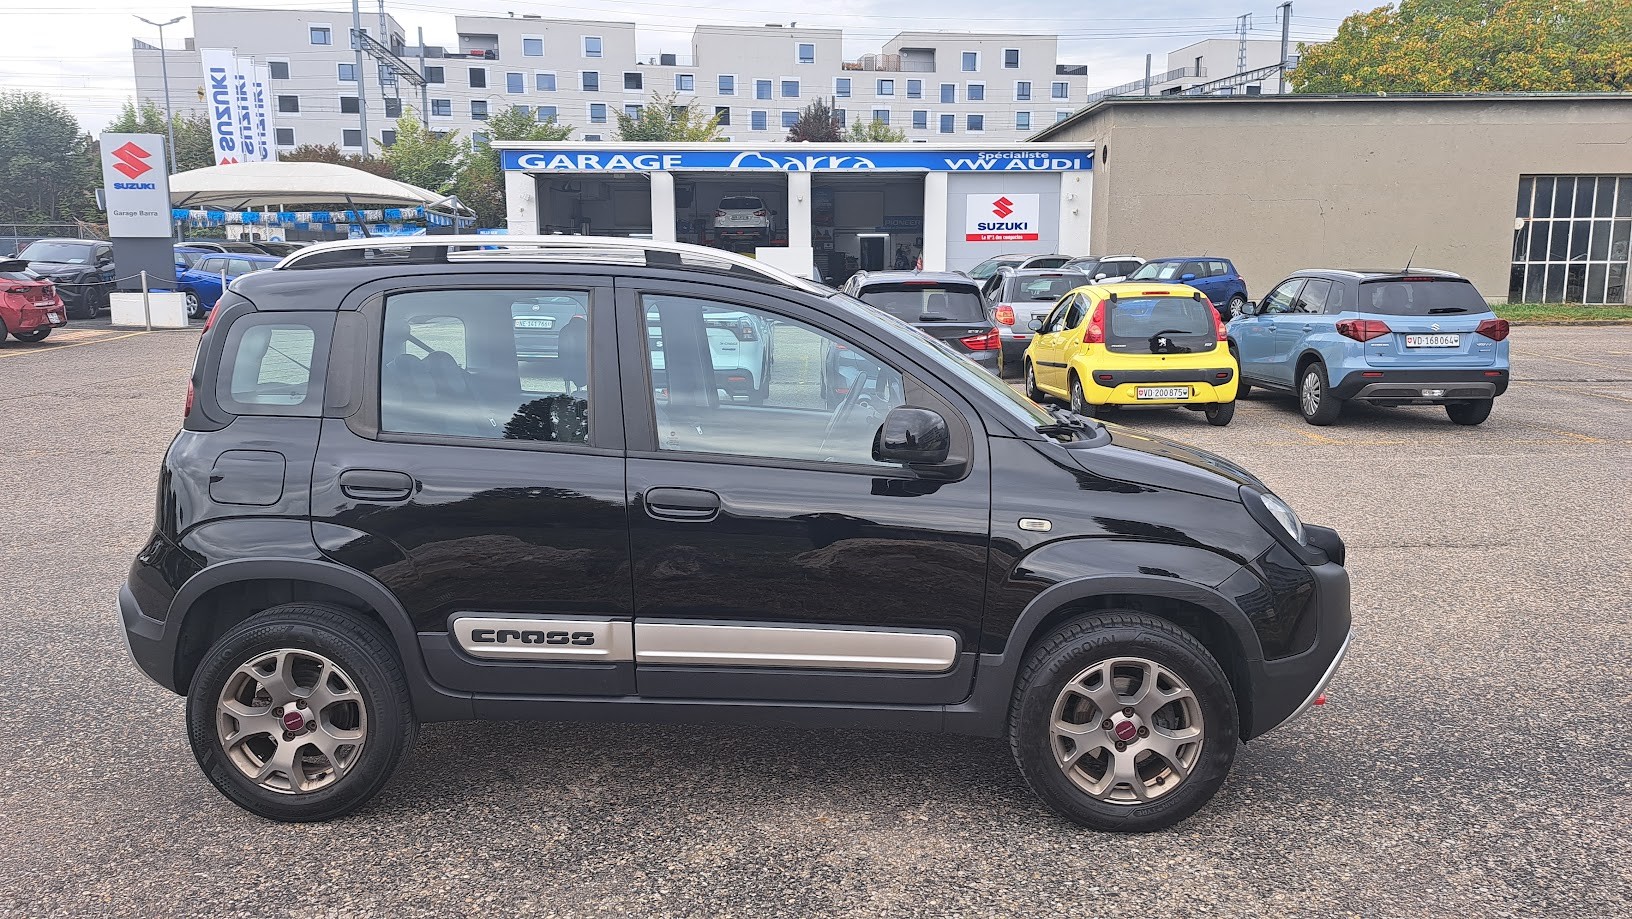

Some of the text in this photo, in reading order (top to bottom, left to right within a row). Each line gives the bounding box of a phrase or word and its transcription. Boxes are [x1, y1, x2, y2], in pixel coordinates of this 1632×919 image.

[977, 151, 1049, 160] Spécialiste
[517, 154, 682, 170] GARAGE
[944, 158, 1080, 170] VW AUDI
[113, 182, 156, 190] SUZUKI
[977, 222, 1028, 231] SUZUKI
[1049, 635, 1116, 673] UNIROYAL
